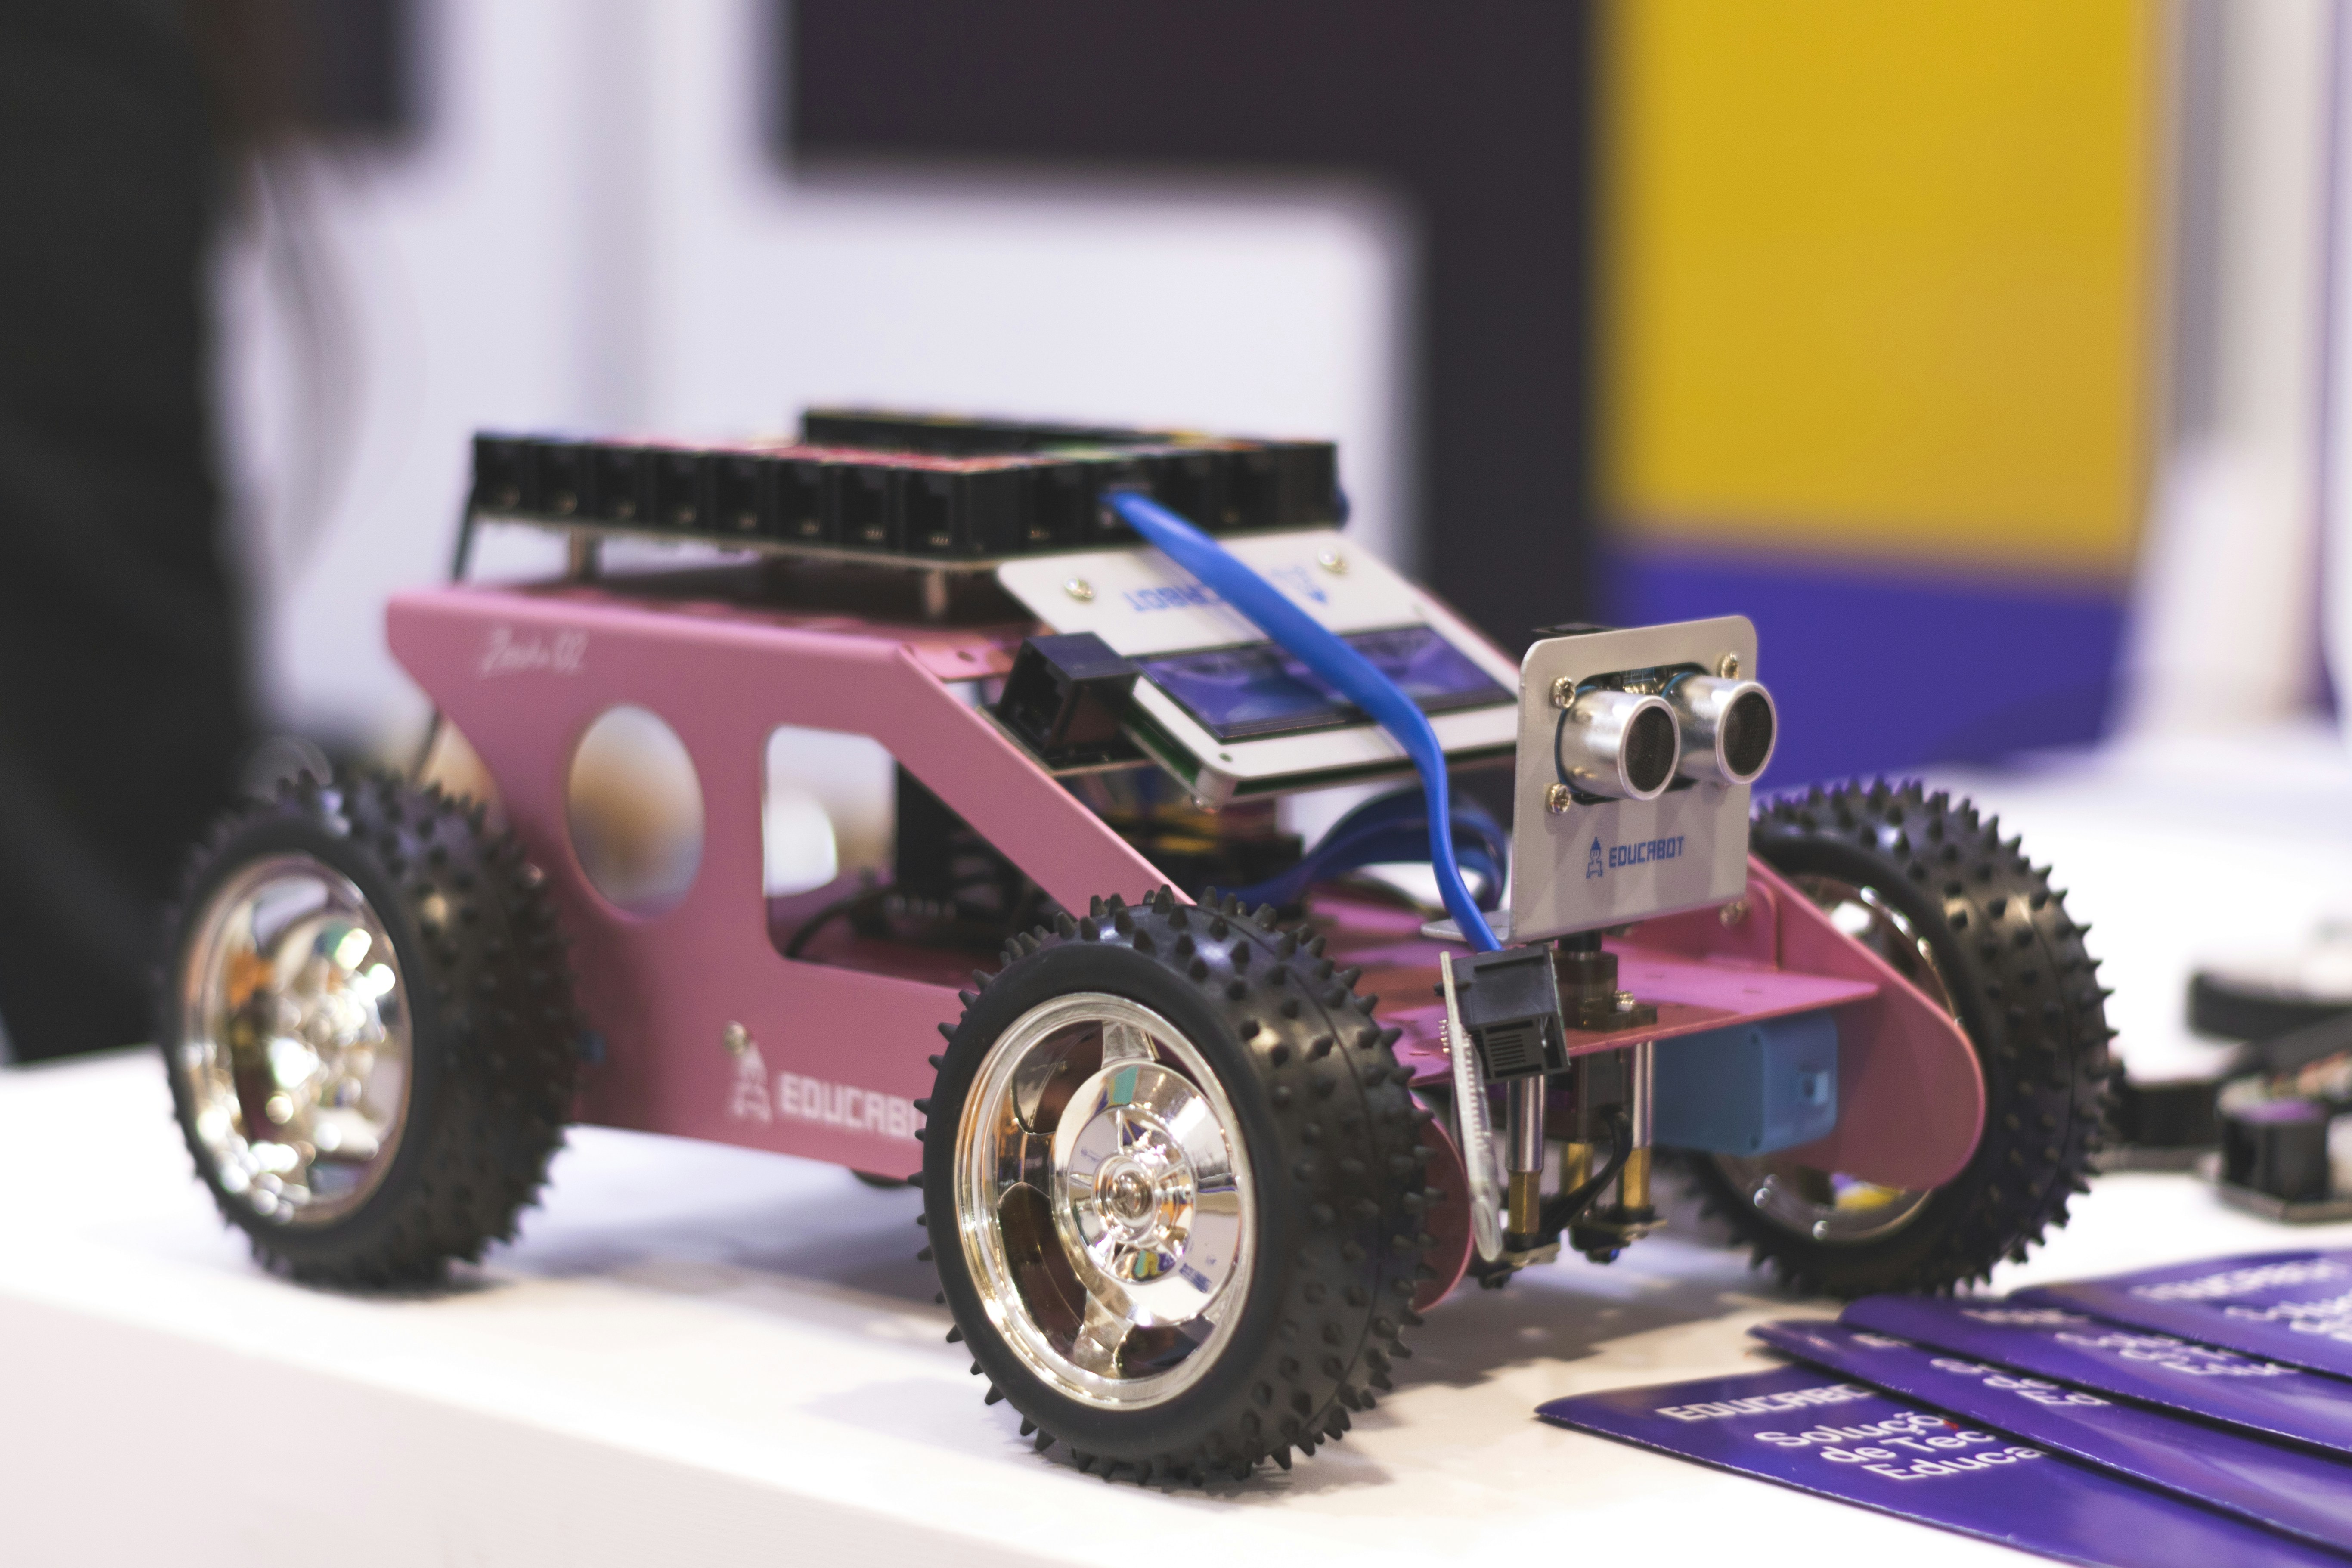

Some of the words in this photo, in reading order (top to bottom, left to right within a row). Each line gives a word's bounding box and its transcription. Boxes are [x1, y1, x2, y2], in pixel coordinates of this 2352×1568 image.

[1609, 835, 1684, 868] EDUCABOT
[1819, 1445, 1897, 1463] de
[1878, 1430, 1996, 1453] Tec
[1861, 1446, 2048, 1480] Educa
